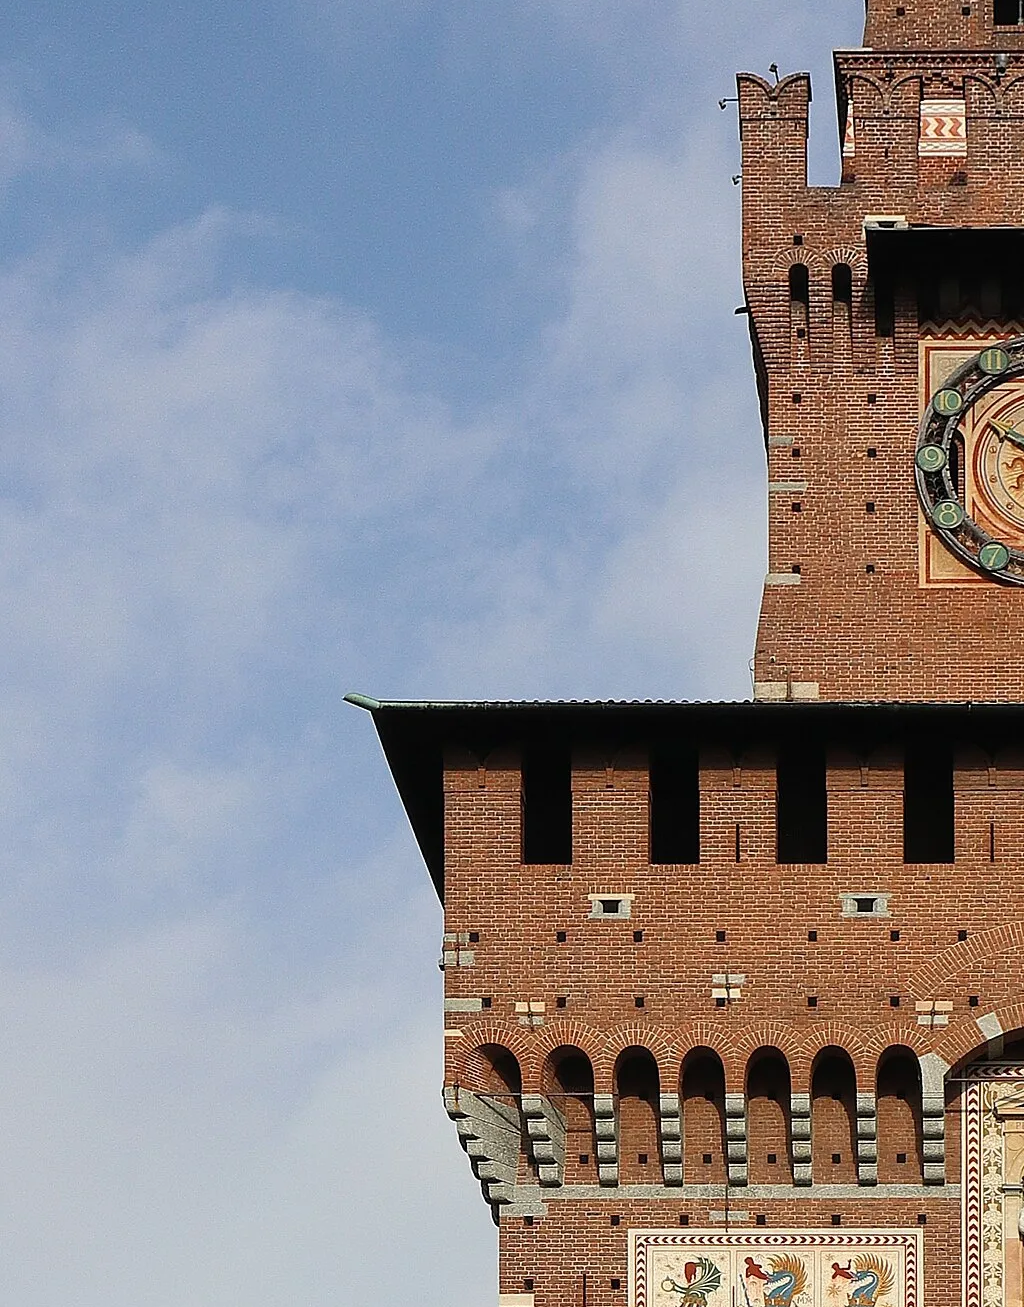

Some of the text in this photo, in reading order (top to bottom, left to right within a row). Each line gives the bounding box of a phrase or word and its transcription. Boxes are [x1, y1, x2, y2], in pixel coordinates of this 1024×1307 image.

[986, 350, 1002, 371] 11
[941, 391, 959, 410] 10
[926, 448, 940, 469] 9
[941, 503, 955, 526] 8
[987, 545, 1001, 568] 7
